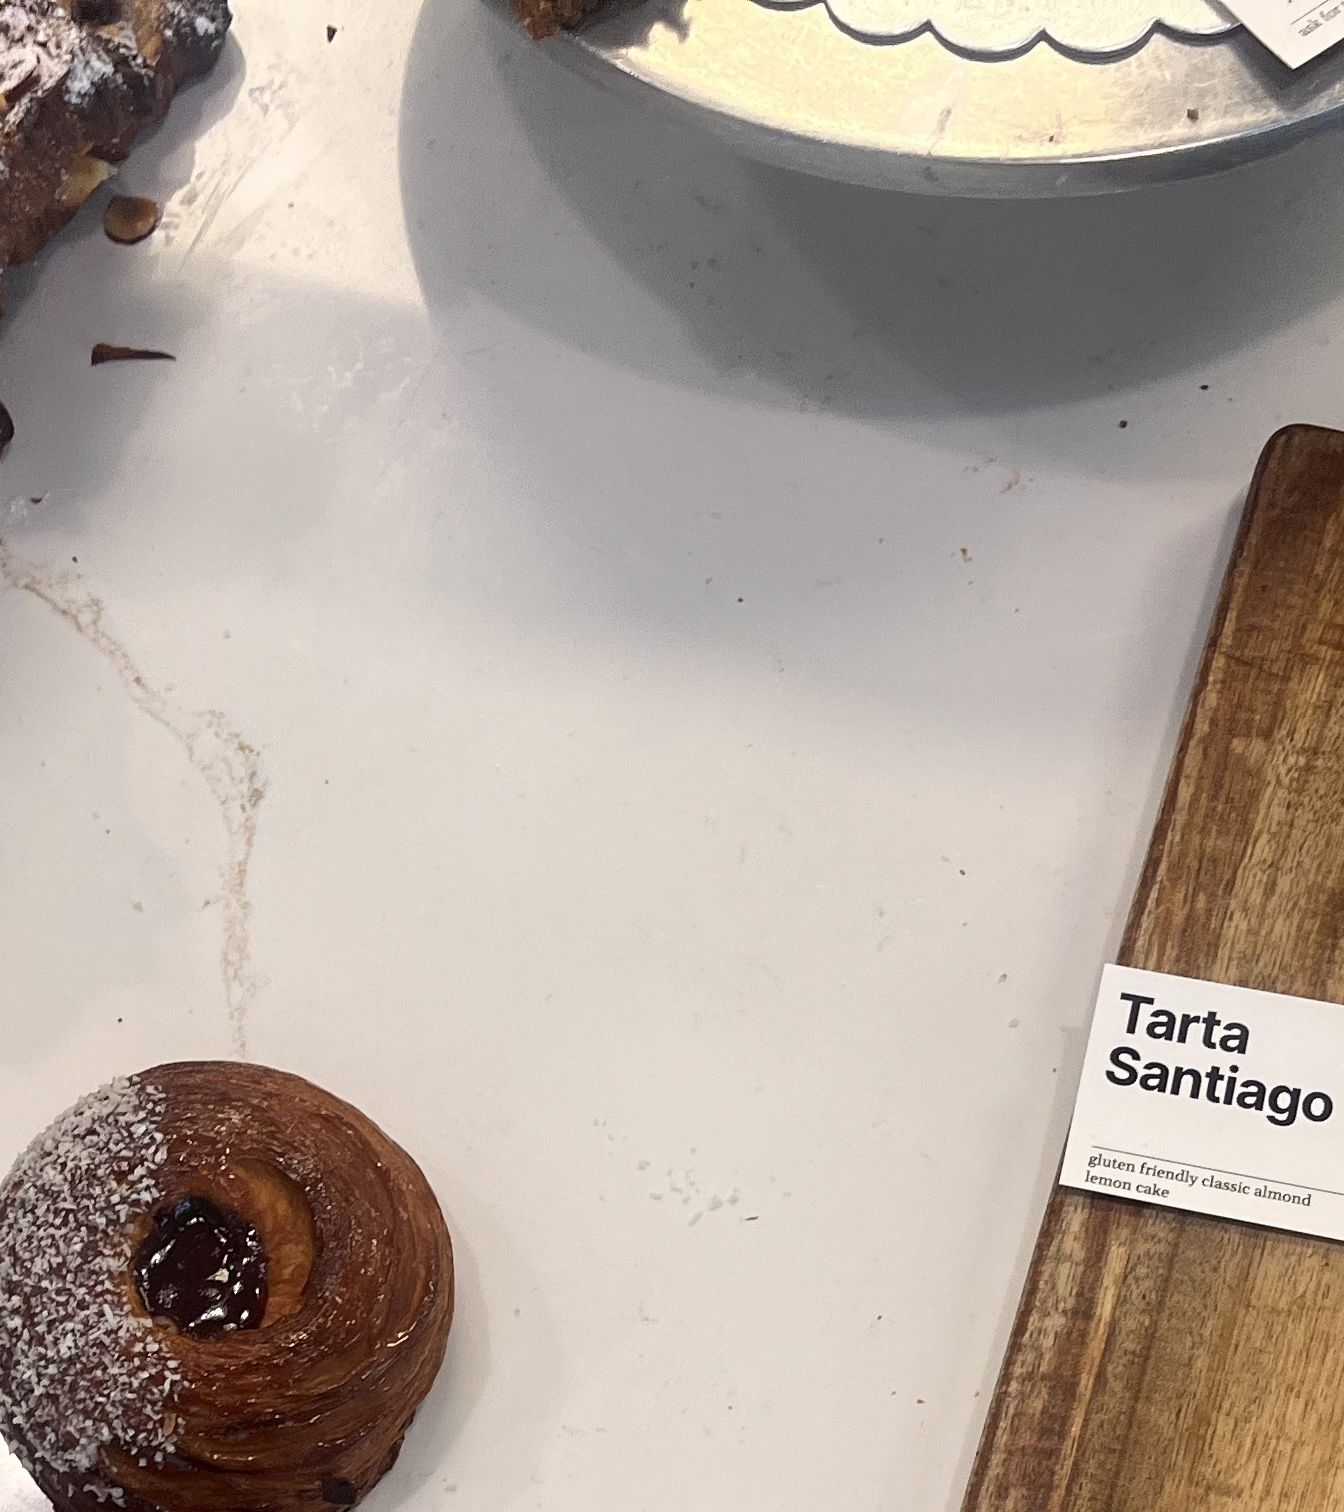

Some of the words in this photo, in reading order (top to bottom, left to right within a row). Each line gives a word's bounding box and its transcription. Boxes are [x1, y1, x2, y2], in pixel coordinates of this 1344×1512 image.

[1120, 992, 1250, 1056] Tarta
[1105, 1046, 1334, 1127] Santiago
[1084, 1171, 1132, 1193] lemon
[1136, 1182, 1170, 1200] cake
[1088, 1153, 1136, 1175] gluten
[1139, 1161, 1199, 1188] friendly
[1201, 1175, 1251, 1196] classic
[1254, 1185, 1312, 1208] almond
